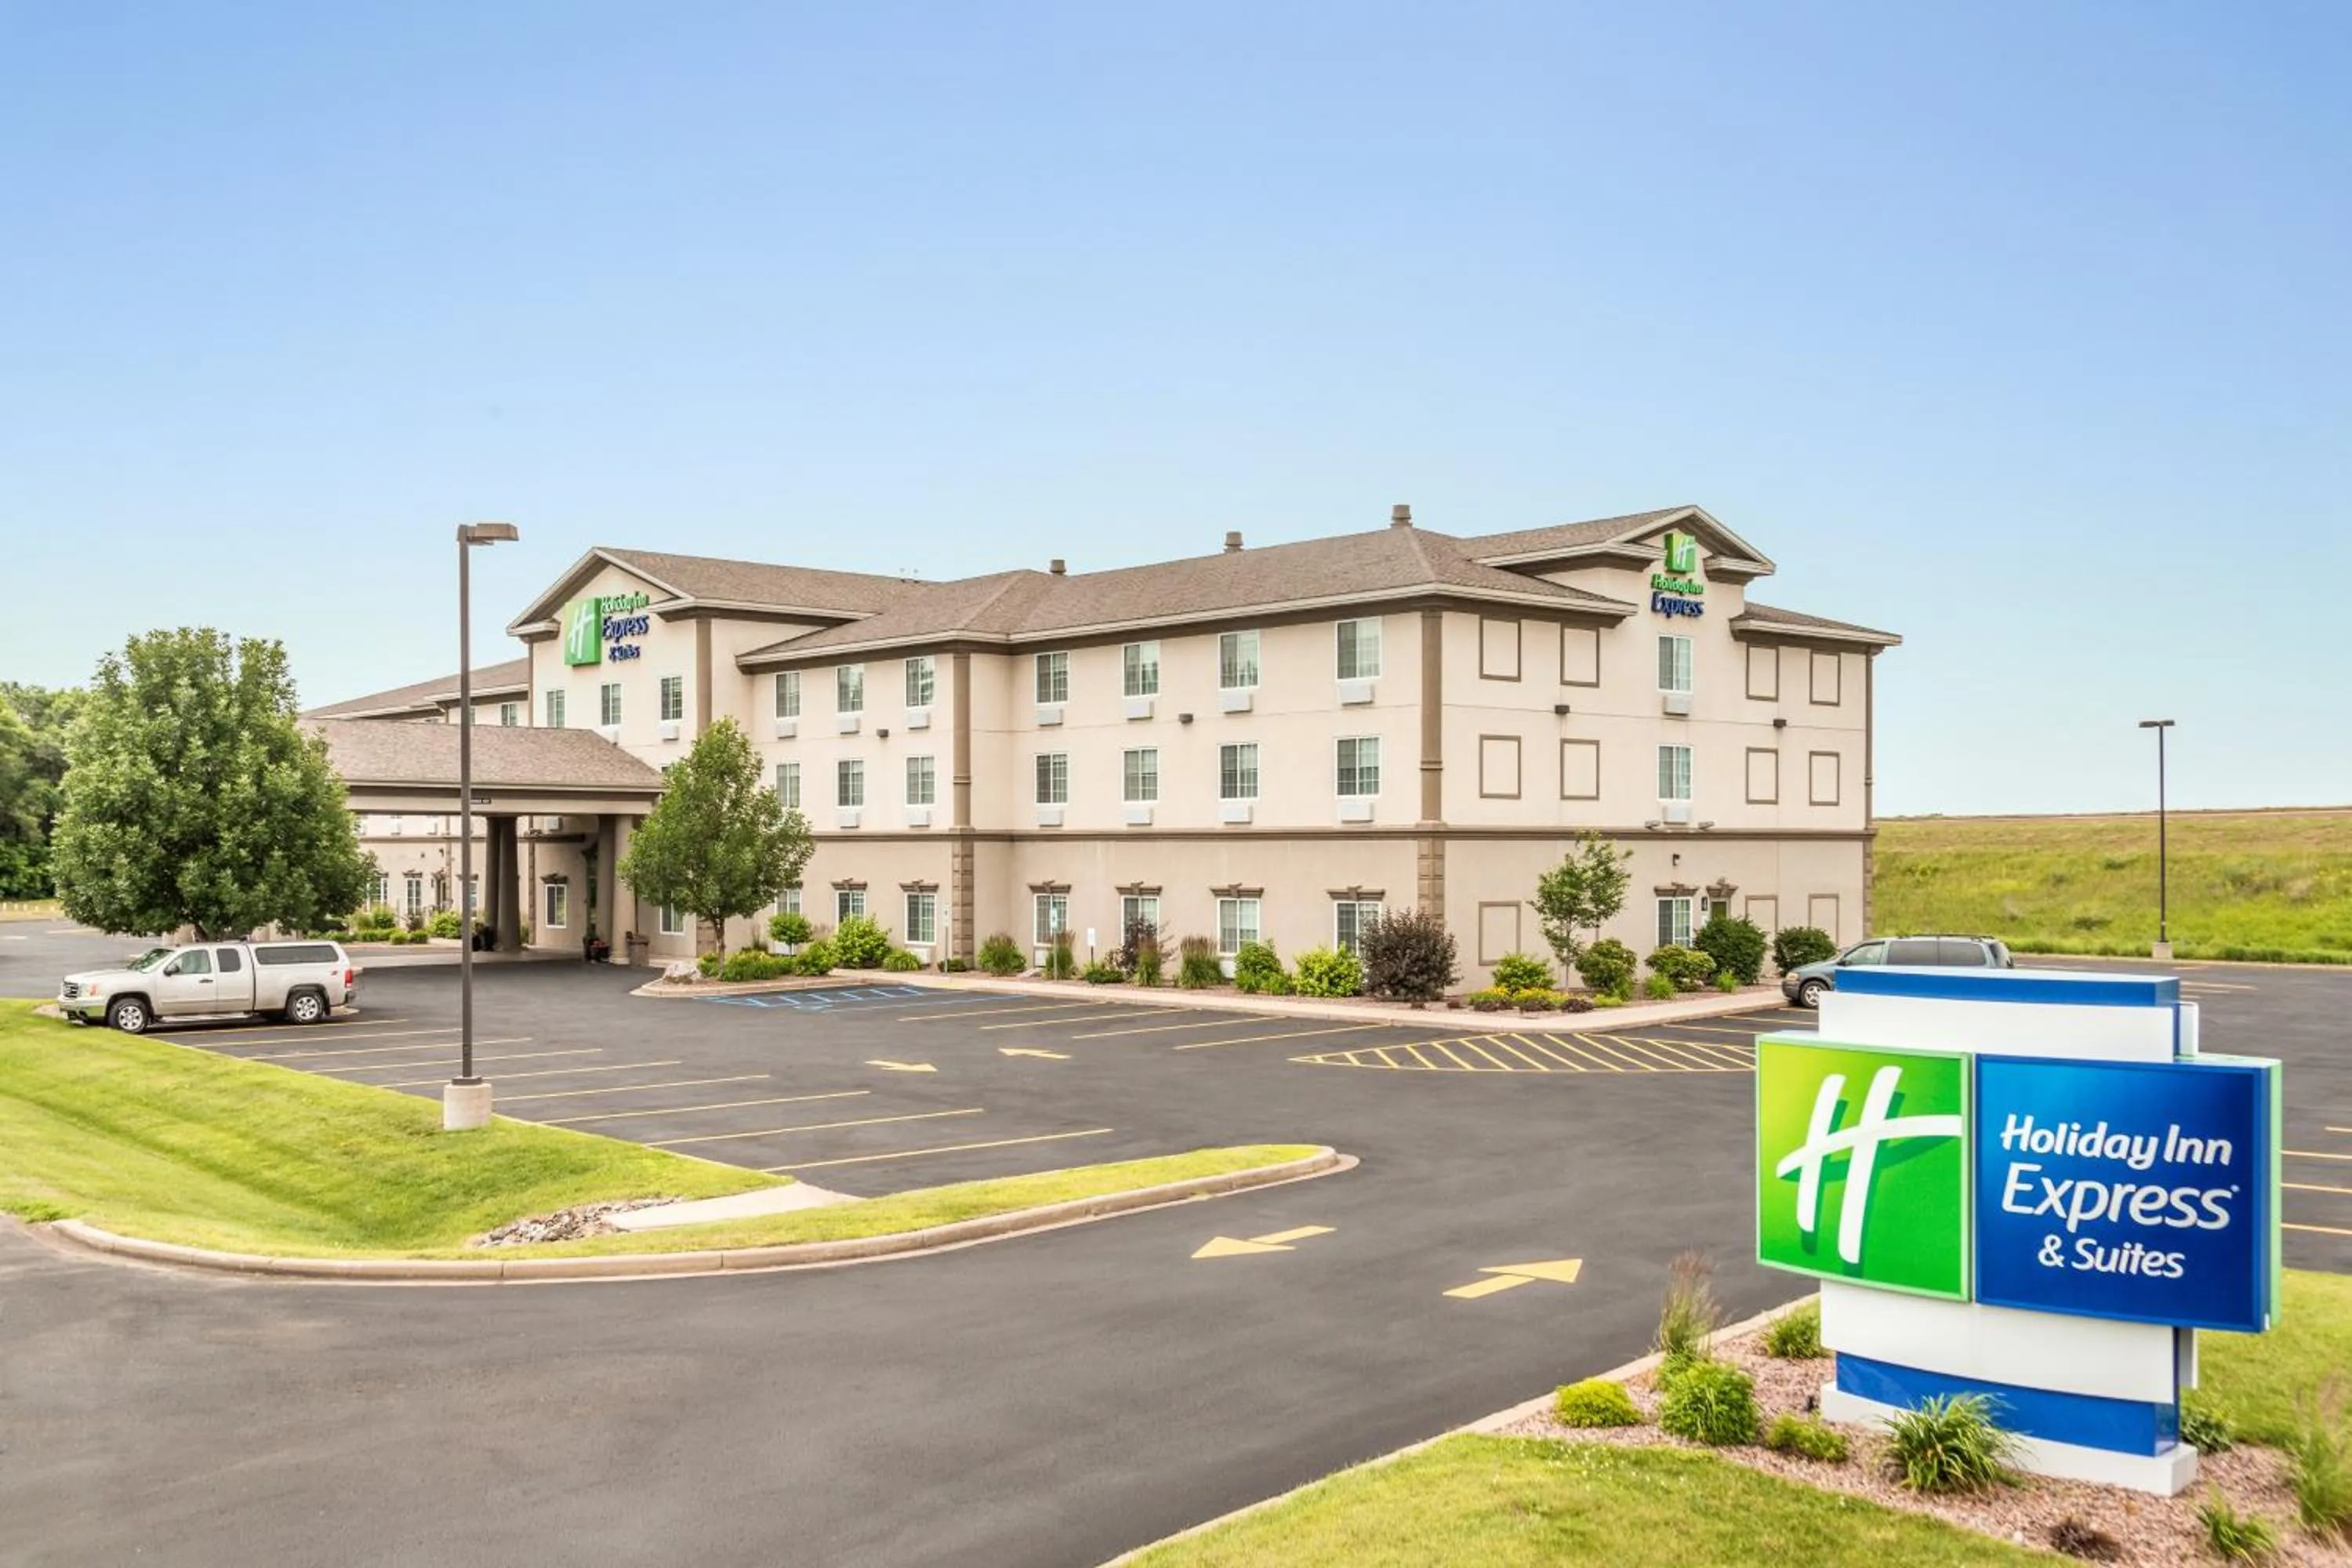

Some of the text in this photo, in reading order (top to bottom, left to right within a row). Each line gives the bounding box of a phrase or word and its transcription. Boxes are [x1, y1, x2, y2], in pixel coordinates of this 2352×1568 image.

[1651, 573, 1688, 596] Holiday
[1651, 591, 1704, 619] Express
[602, 615, 650, 643] Express
[2000, 1113, 2233, 1171] Holiday Inn
[2001, 1161, 2234, 1233] Express
[2038, 1233, 2186, 1279] & Suites
